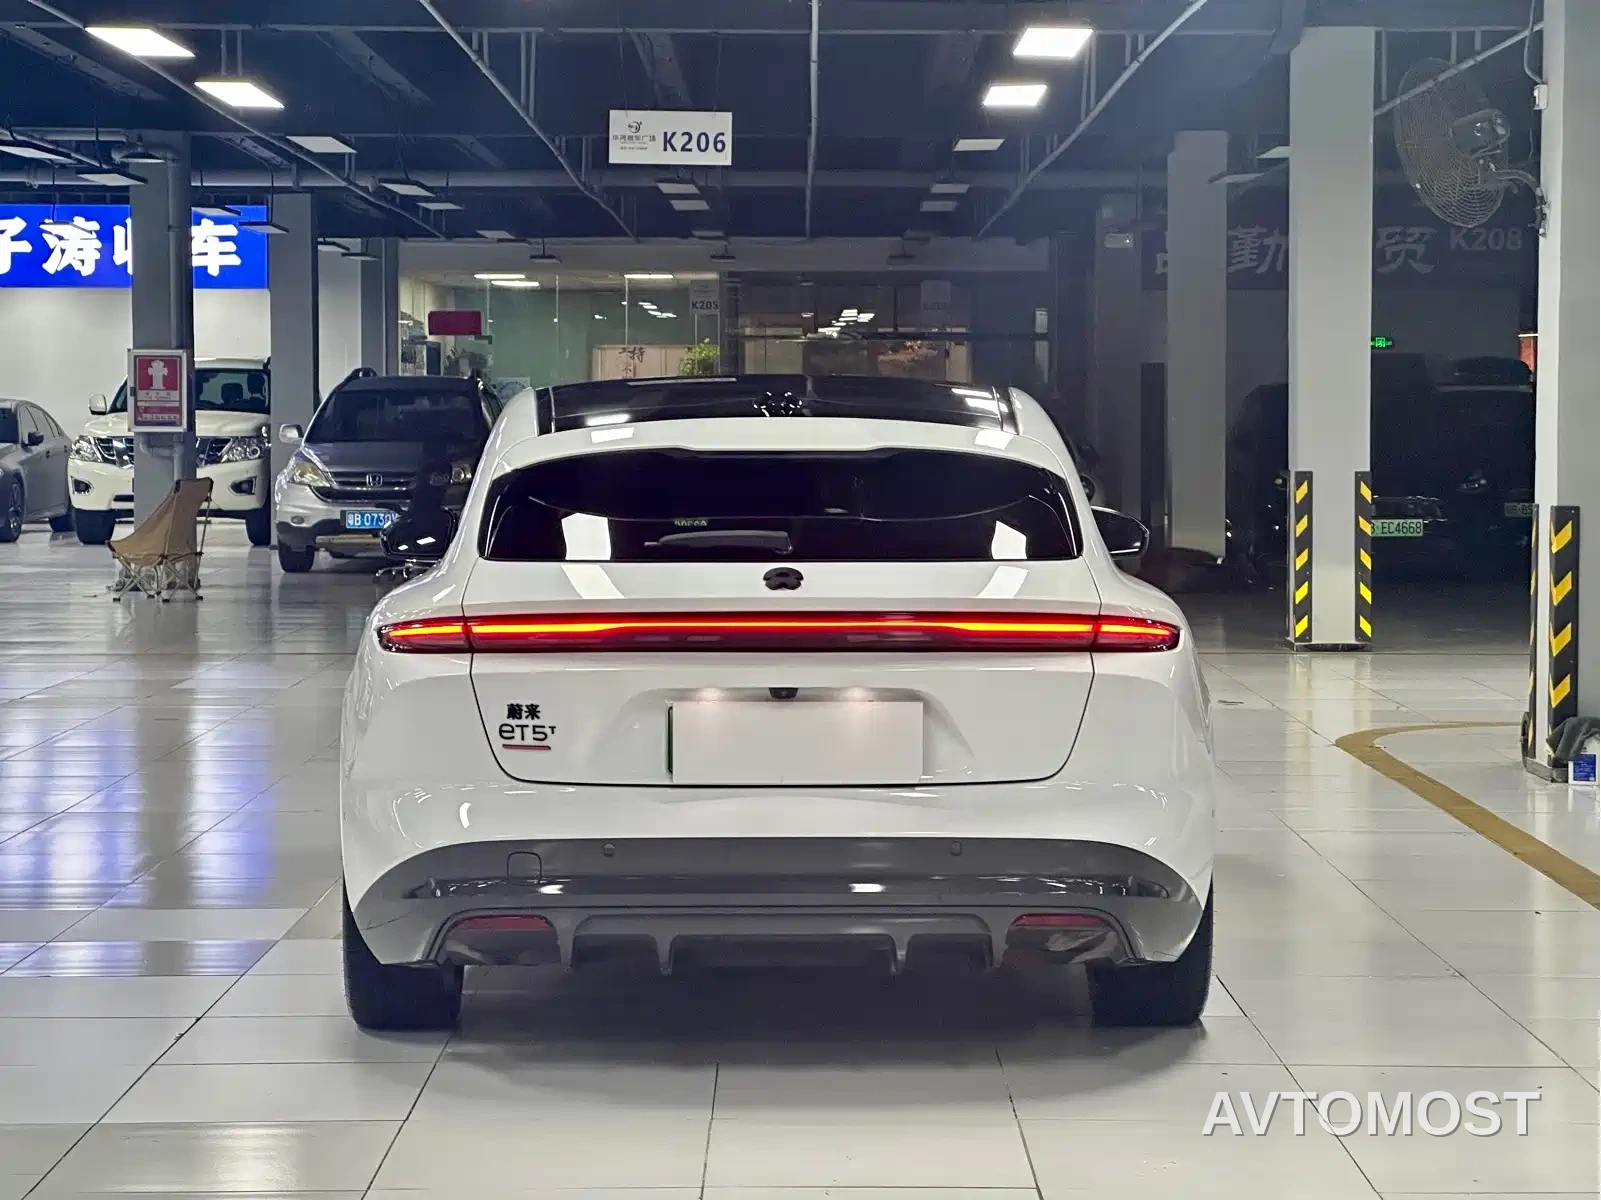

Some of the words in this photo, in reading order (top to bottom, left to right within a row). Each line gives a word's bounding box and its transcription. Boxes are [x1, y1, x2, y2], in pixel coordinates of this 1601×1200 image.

[662, 131, 726, 153] K206
[1451, 227, 1522, 251] K208
[506, 703, 541, 720] 蔚来
